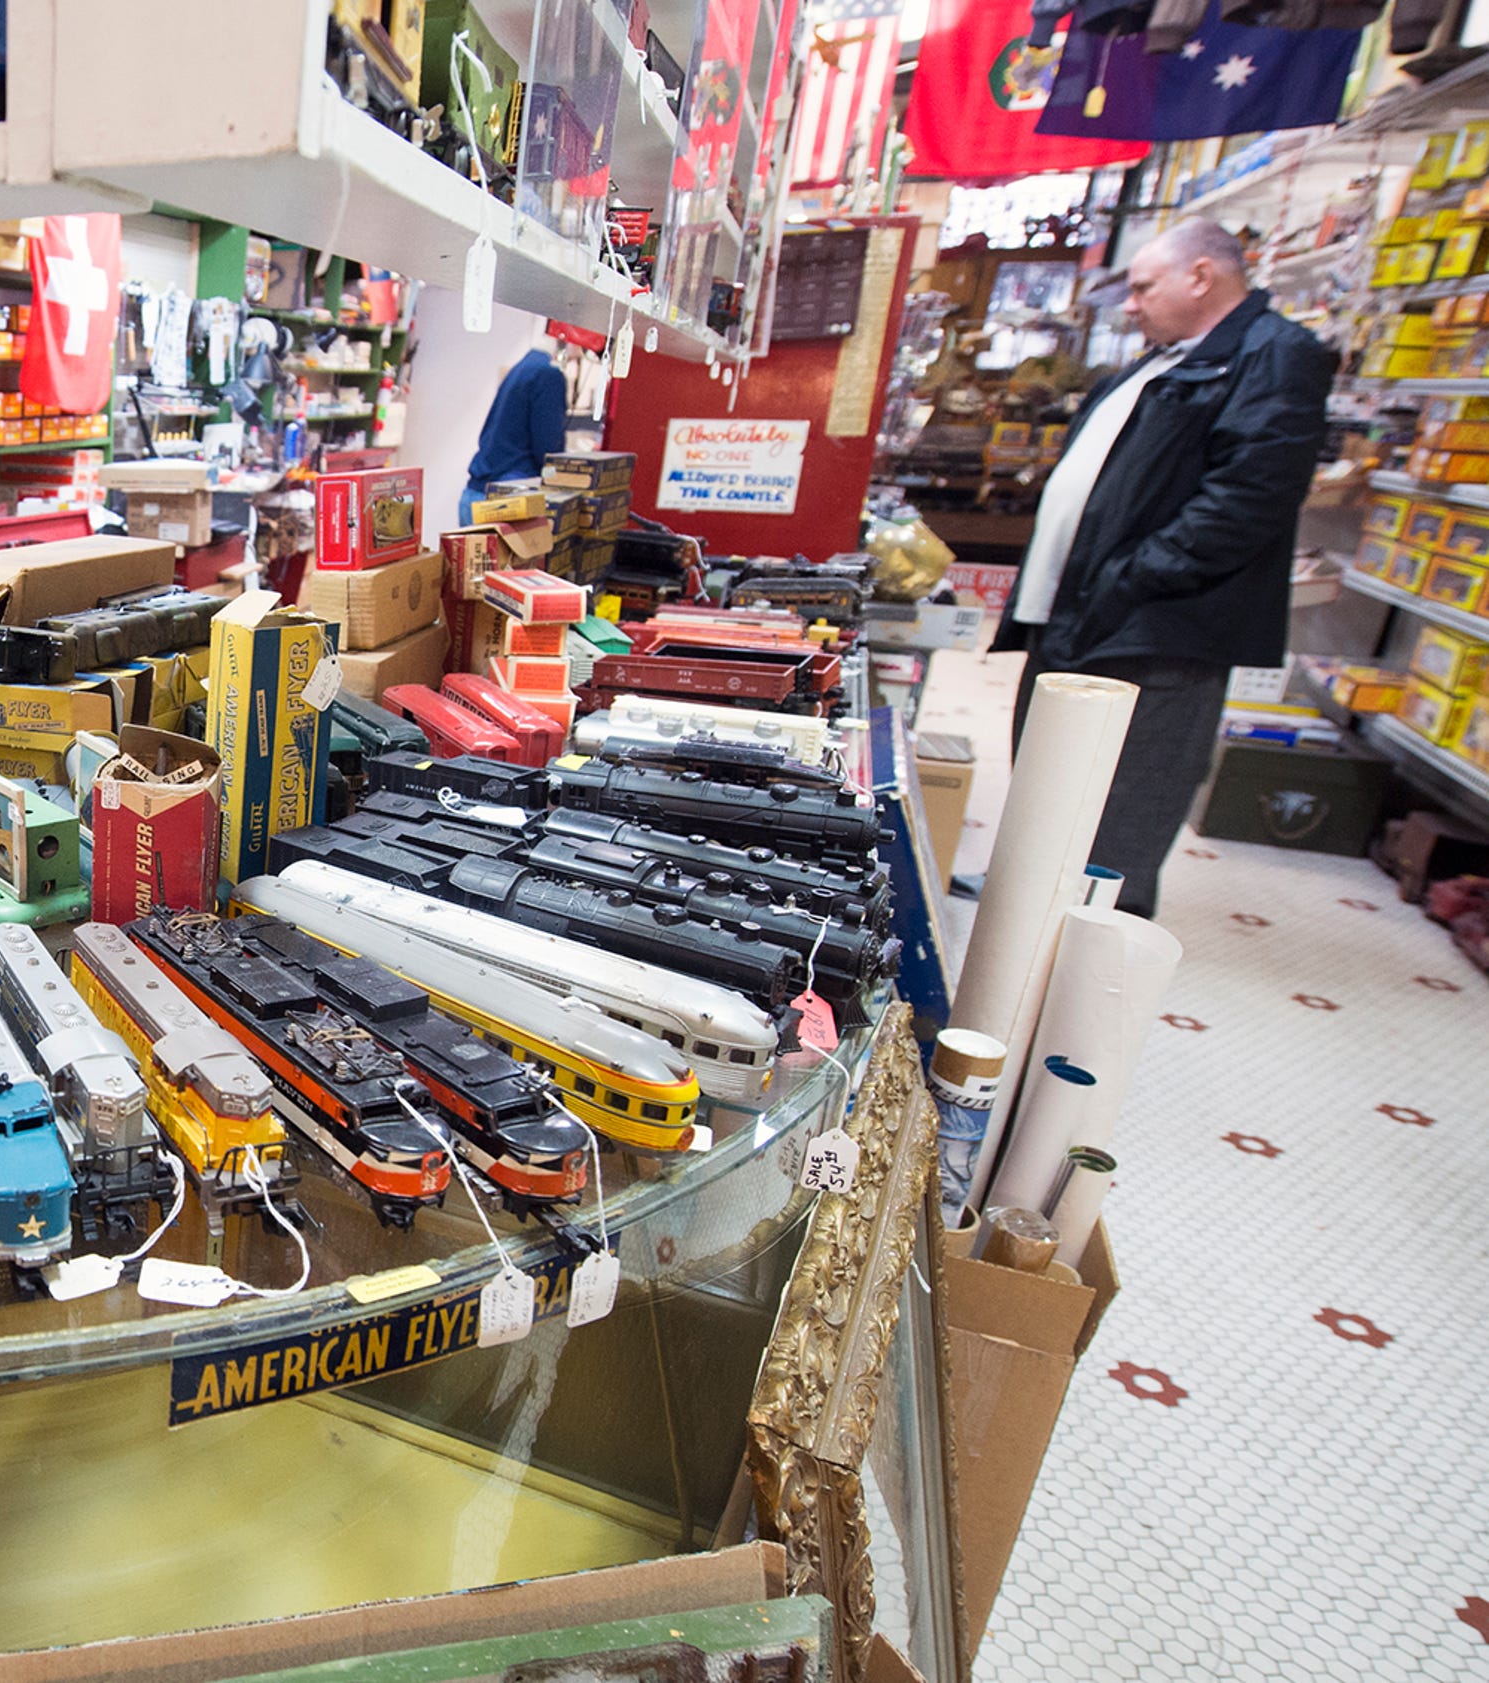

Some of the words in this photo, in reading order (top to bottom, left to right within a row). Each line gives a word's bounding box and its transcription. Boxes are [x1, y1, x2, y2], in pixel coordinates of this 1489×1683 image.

[686, 450, 710, 461] NO
[715, 450, 751, 461] ONE
[680, 486, 710, 498] THE
[287, 638, 311, 712] FLYER
[8, 700, 52, 720] FLYER
[221, 683, 241, 789] AMERICAN
[124, 758, 150, 782] RAIL
[277, 744, 303, 836] ERICAN
[136, 822, 153, 877] FLYER
[273, 1074, 314, 1113] HAVEN
[806, 1156, 824, 1186] SALE
[176, 1325, 390, 1413] AMERICAN
[404, 1298, 481, 1362] FLYE
